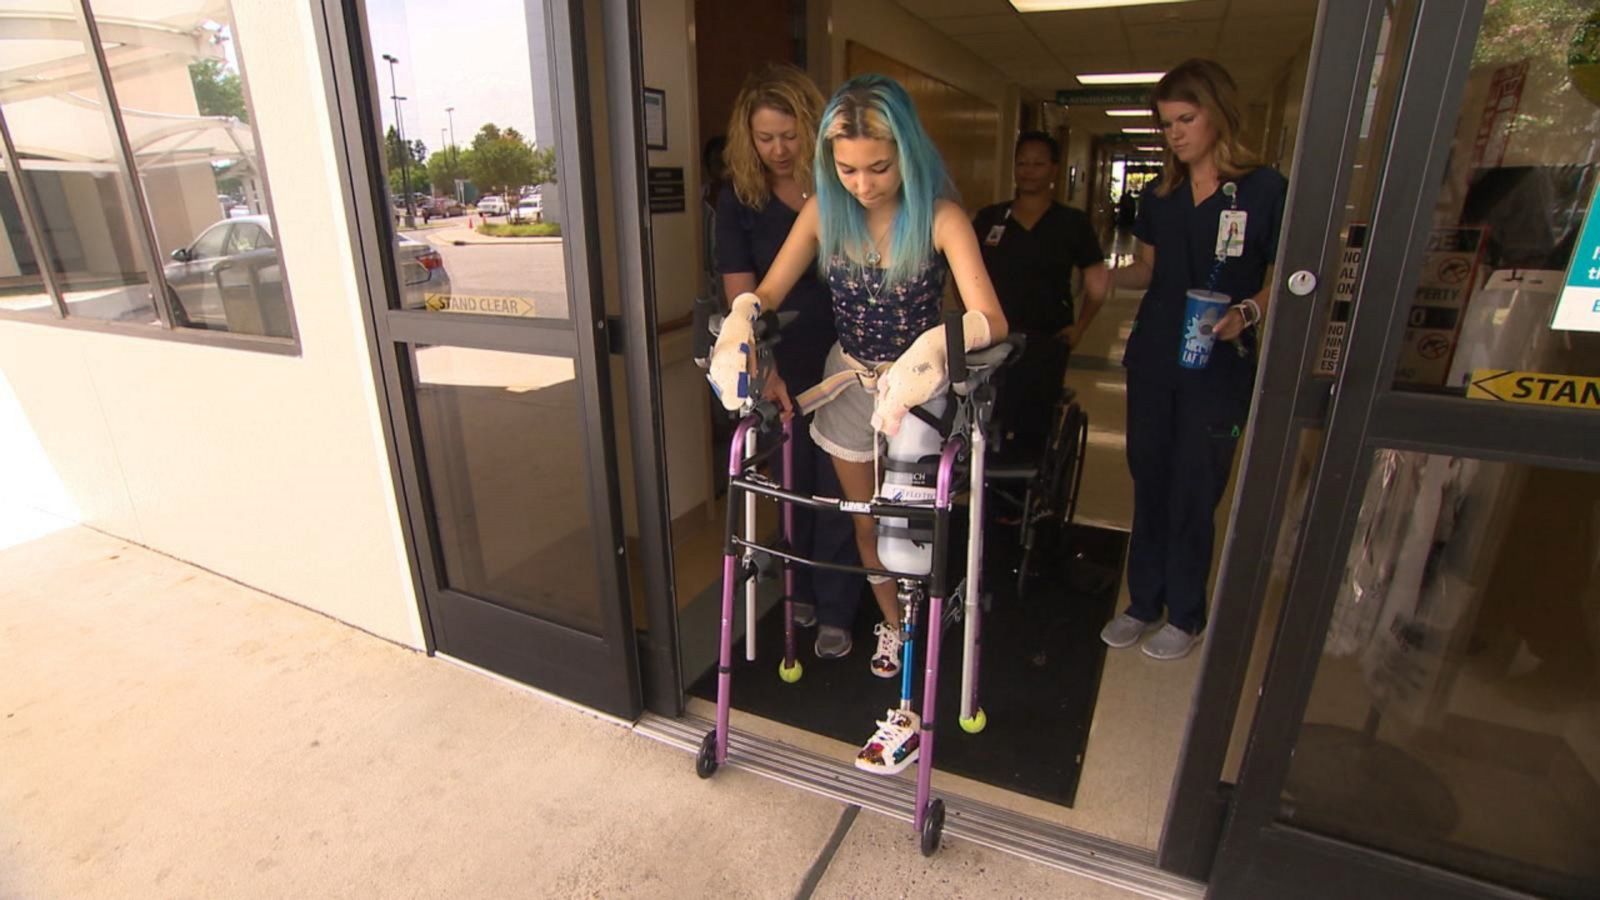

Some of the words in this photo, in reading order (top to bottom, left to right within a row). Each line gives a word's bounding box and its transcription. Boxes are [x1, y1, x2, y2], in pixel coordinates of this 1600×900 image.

[1344, 252, 1361, 263] NO
[438, 296, 477, 311] STAND
[480, 298, 518, 313] CLEAR
[1328, 325, 1343, 336] NO
[1320, 360, 1337, 371] ES
